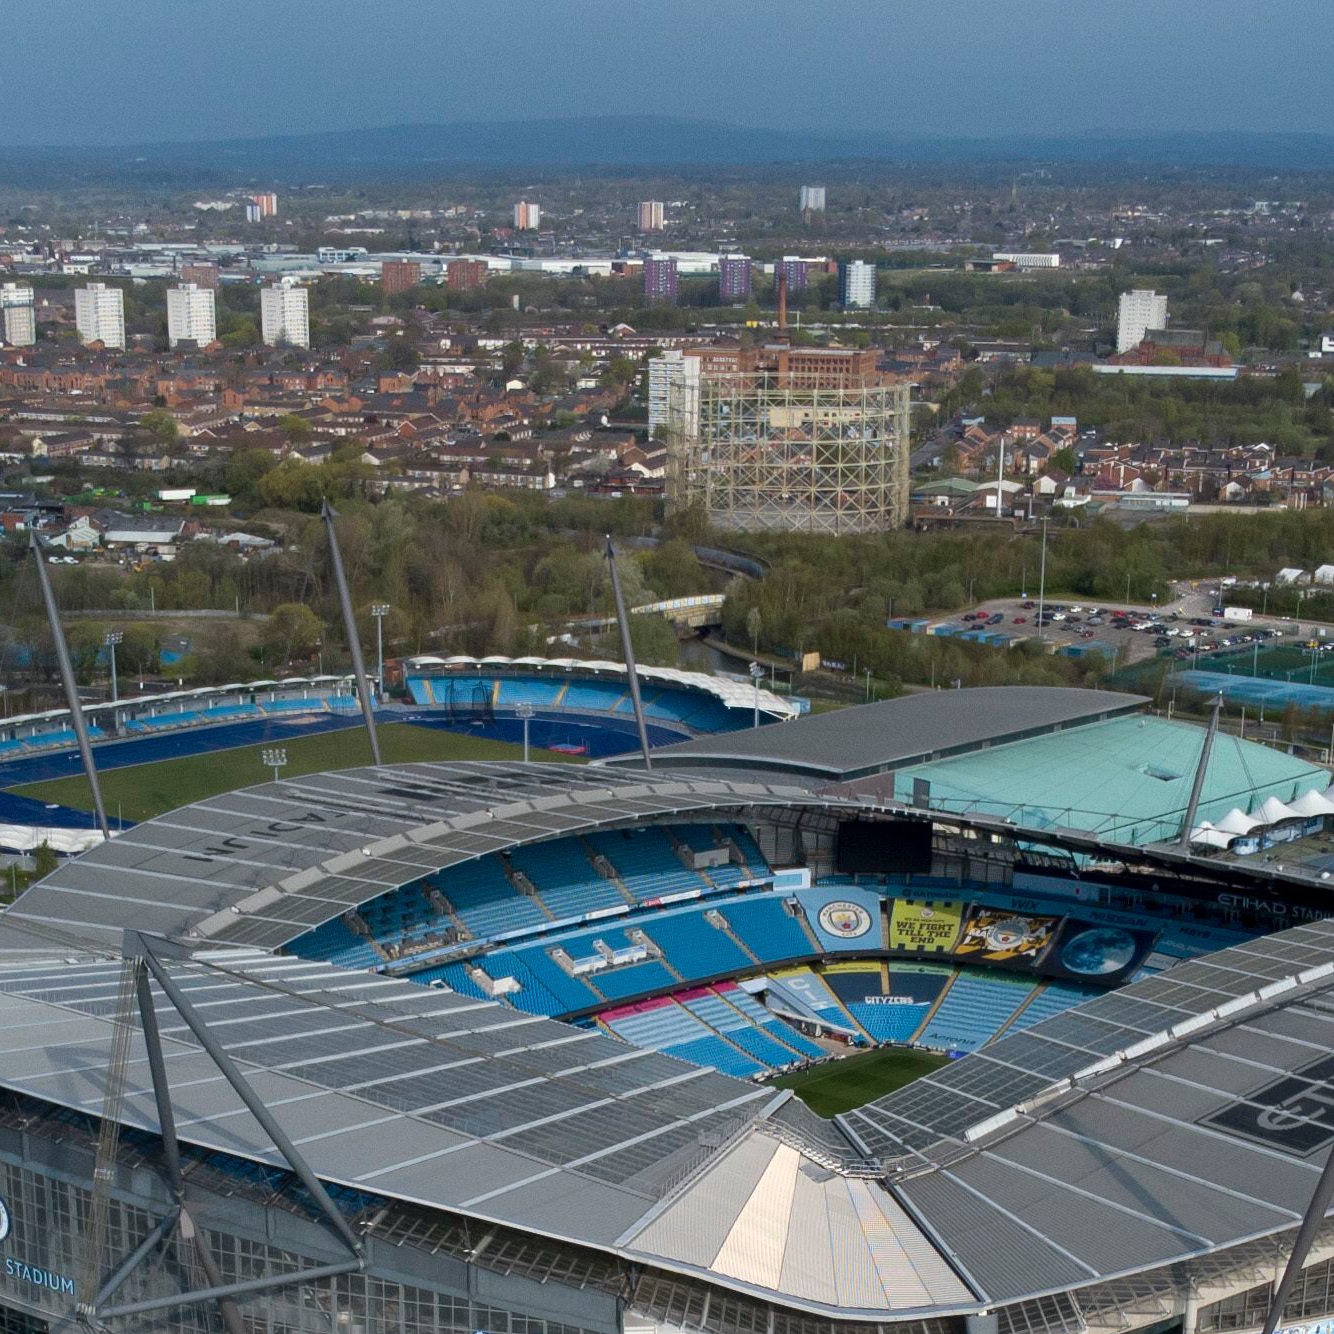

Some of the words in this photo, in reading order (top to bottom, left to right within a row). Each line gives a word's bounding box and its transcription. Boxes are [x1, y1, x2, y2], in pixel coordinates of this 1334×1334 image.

[1217, 893, 1287, 914] ETIHAD
[896, 920, 916, 930] WE
[919, 922, 955, 931] FIGHT
[897, 929, 924, 937] TILL
[928, 930, 951, 938] THE
[910, 936, 935, 945] END
[864, 995, 915, 1005] CITYZENS
[6, 1258, 75, 1296] STADIUM
